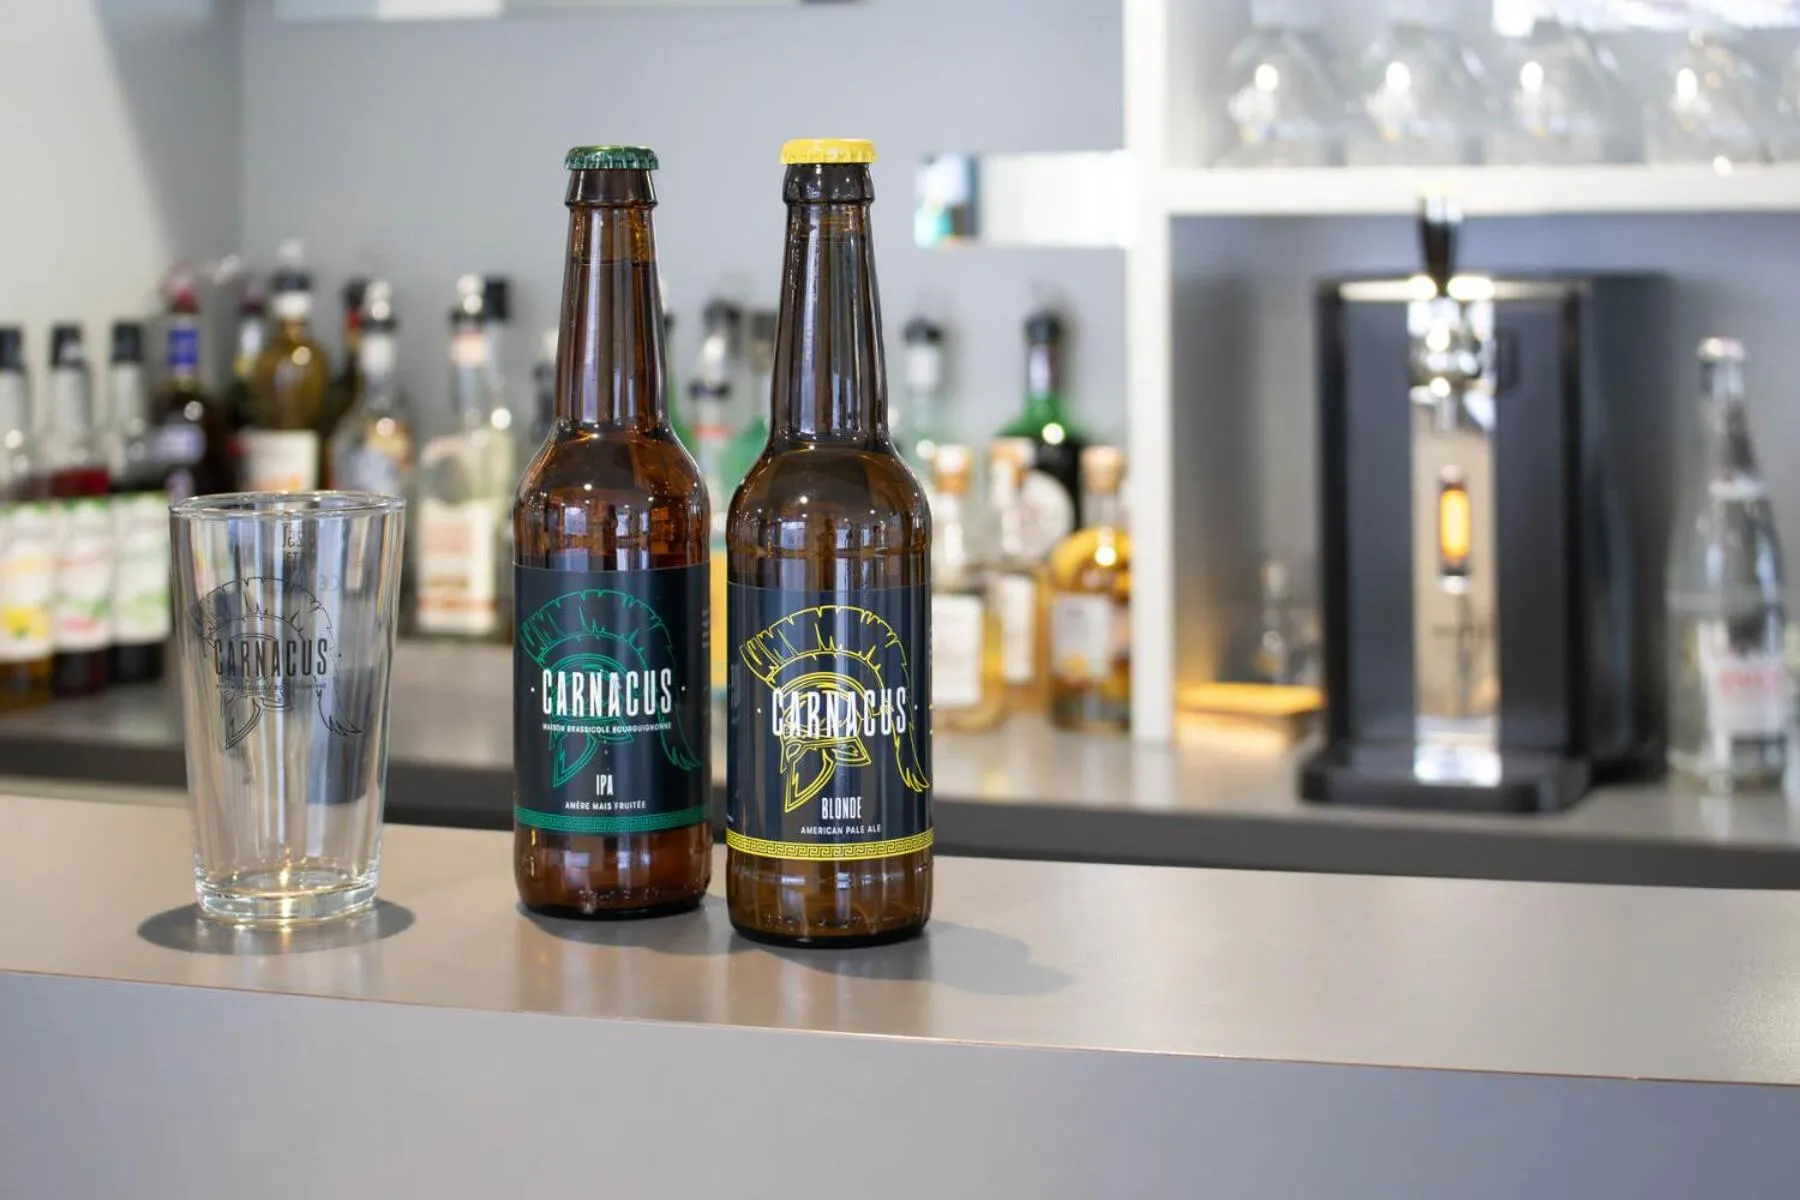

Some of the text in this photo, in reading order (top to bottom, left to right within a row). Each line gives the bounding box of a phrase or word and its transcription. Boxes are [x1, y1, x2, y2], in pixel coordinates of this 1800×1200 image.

[214, 638, 328, 677] CARNACUS
[542, 668, 672, 717] CARNACUS
[772, 686, 907, 739] CARNACUS
[567, 724, 610, 733] BRASSICOLE
[596, 774, 614, 796] IPA
[592, 801, 612, 810] MAIS
[614, 799, 646, 810] FRUITÉE
[821, 796, 862, 819] BLONDE
[801, 824, 881, 835] AMERICAN PALE ALE
